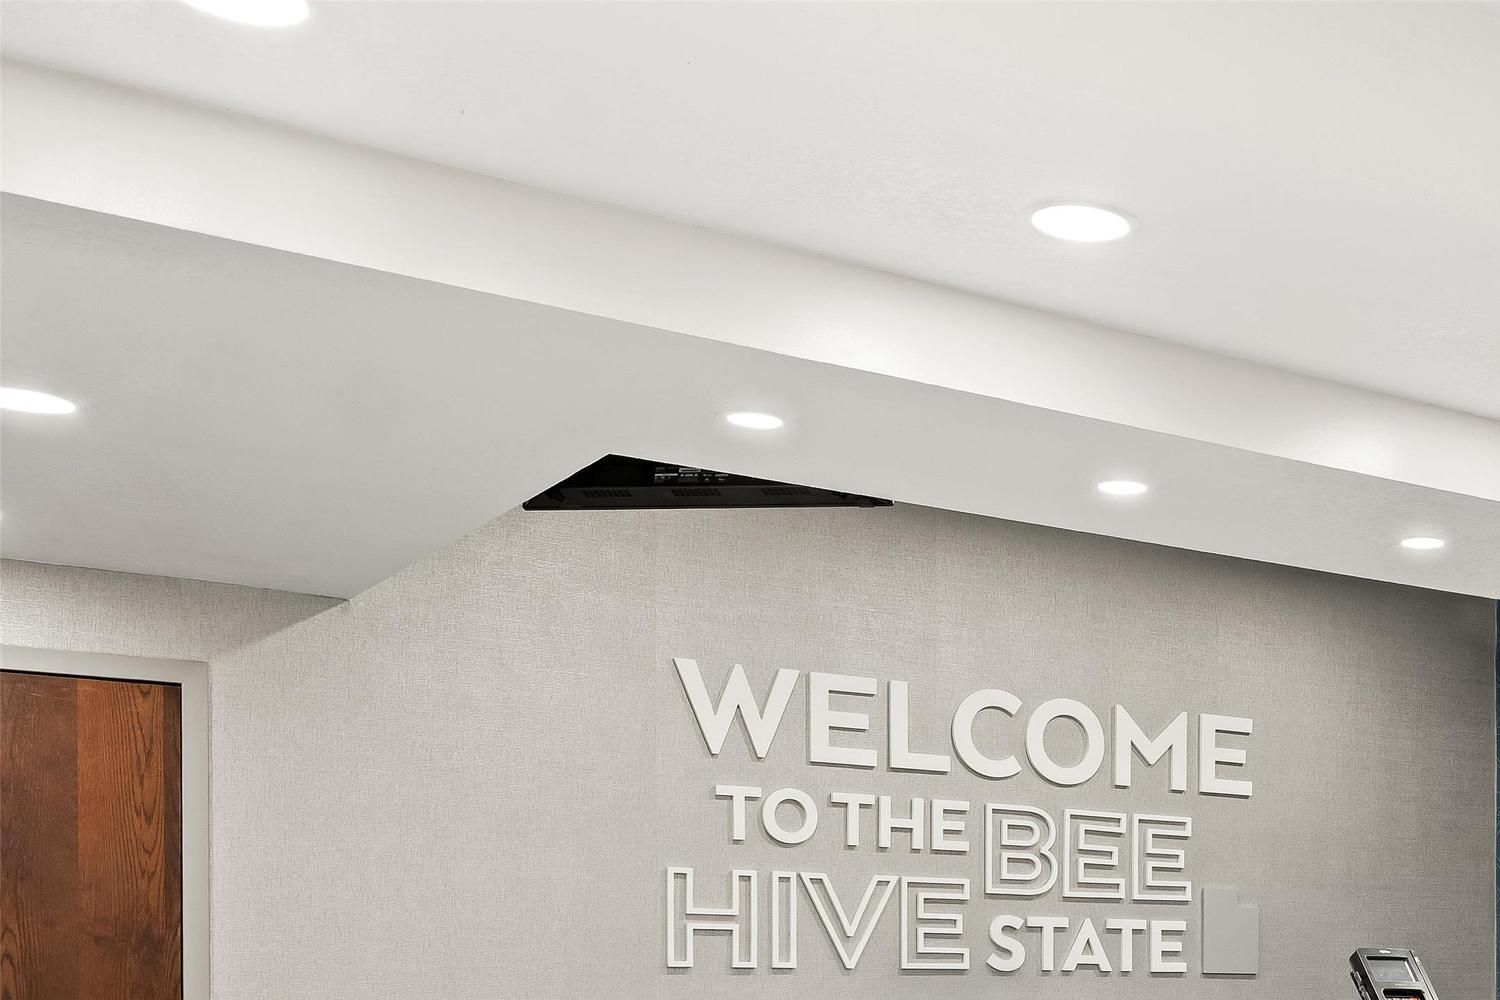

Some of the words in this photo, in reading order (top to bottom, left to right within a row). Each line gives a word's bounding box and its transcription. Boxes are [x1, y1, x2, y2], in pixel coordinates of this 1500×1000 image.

[673, 657, 1253, 796] WELCOME
[715, 784, 818, 845] TO
[831, 791, 970, 852] THE
[985, 803, 1192, 902] BEE
[666, 866, 970, 970] HIVE
[985, 914, 1187, 973] STATE
